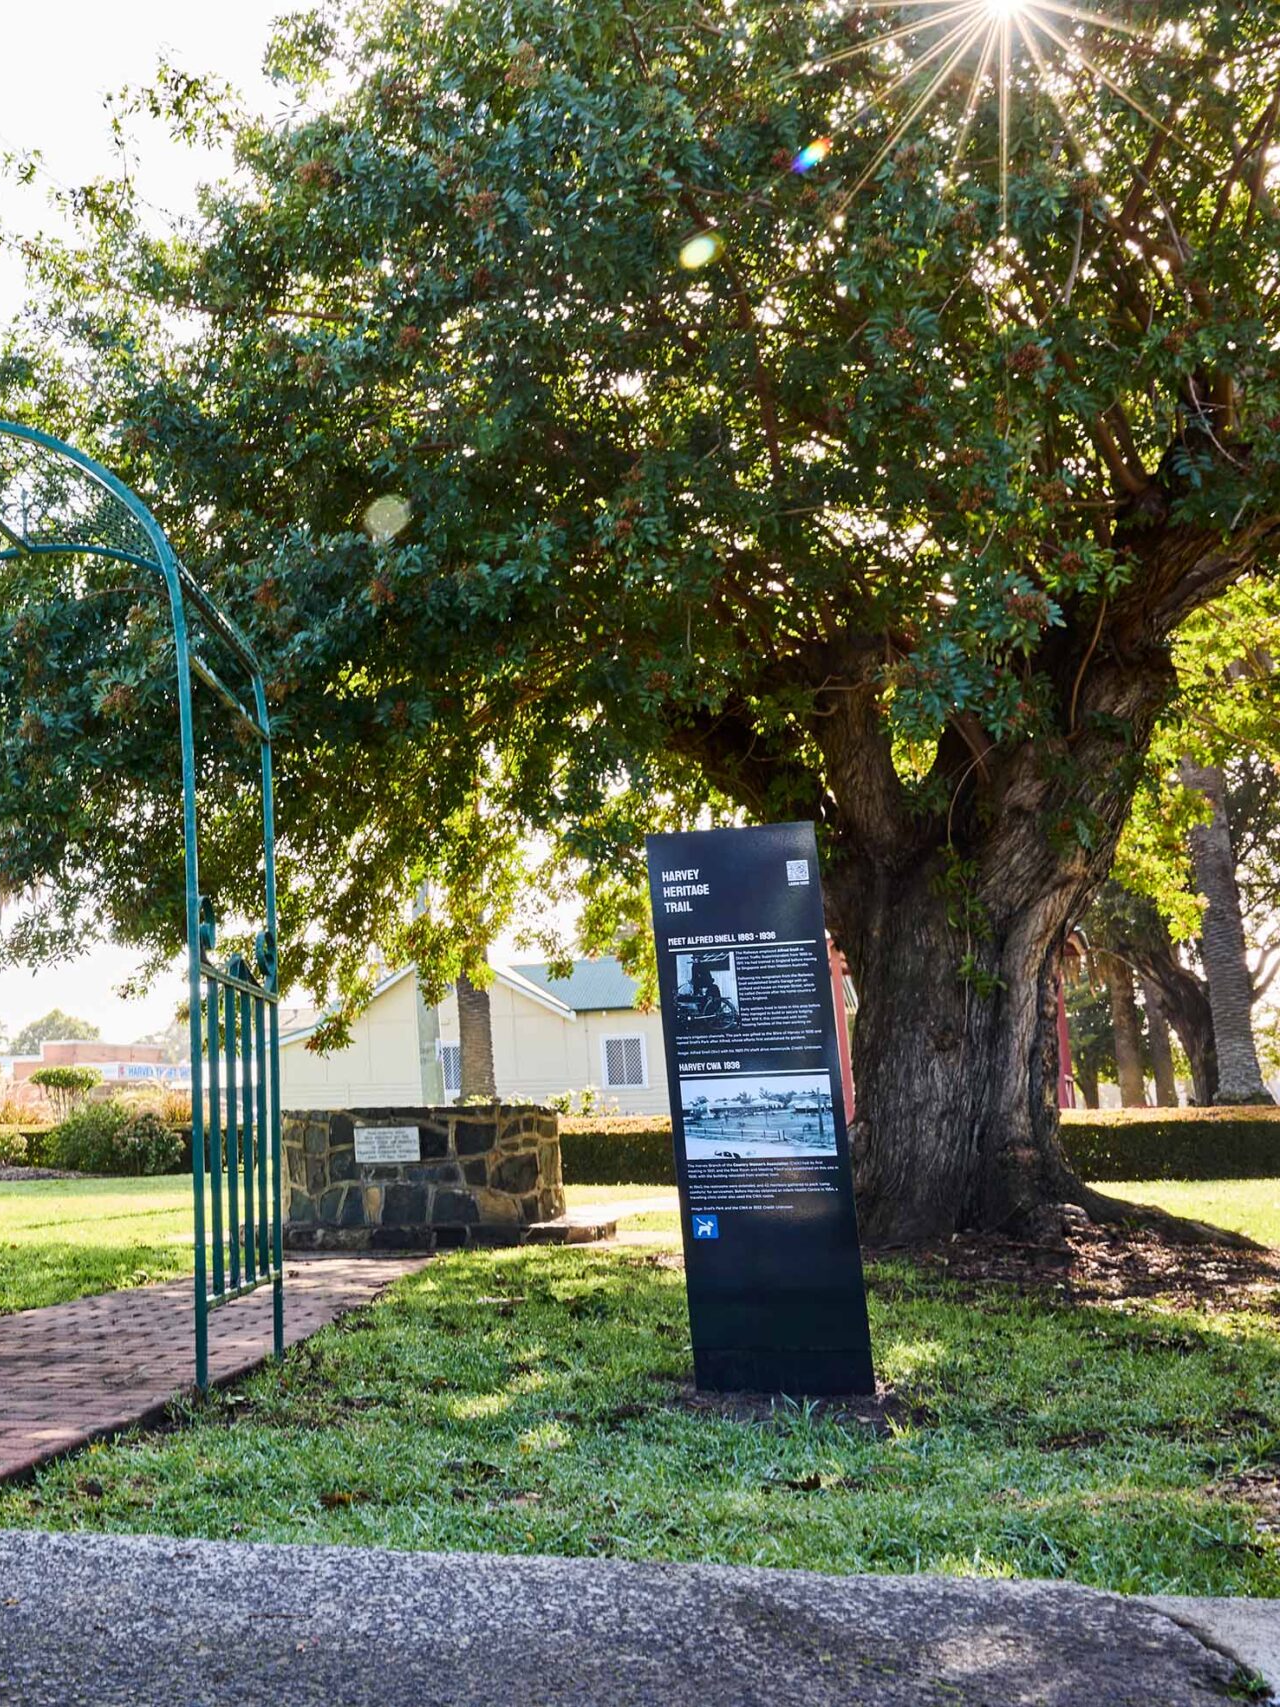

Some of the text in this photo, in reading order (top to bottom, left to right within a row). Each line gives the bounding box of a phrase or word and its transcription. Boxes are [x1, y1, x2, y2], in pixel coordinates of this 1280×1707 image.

[661, 868, 699, 882] HARVEY
[663, 883, 710, 898] HERITAGE
[664, 900, 693, 913] TRAIL
[668, 937, 686, 946] MEET
[687, 935, 714, 945] ALFRED
[714, 934, 736, 943] SNELL
[679, 1062, 705, 1072] HARVEY
[706, 1062, 722, 1070] CWA
